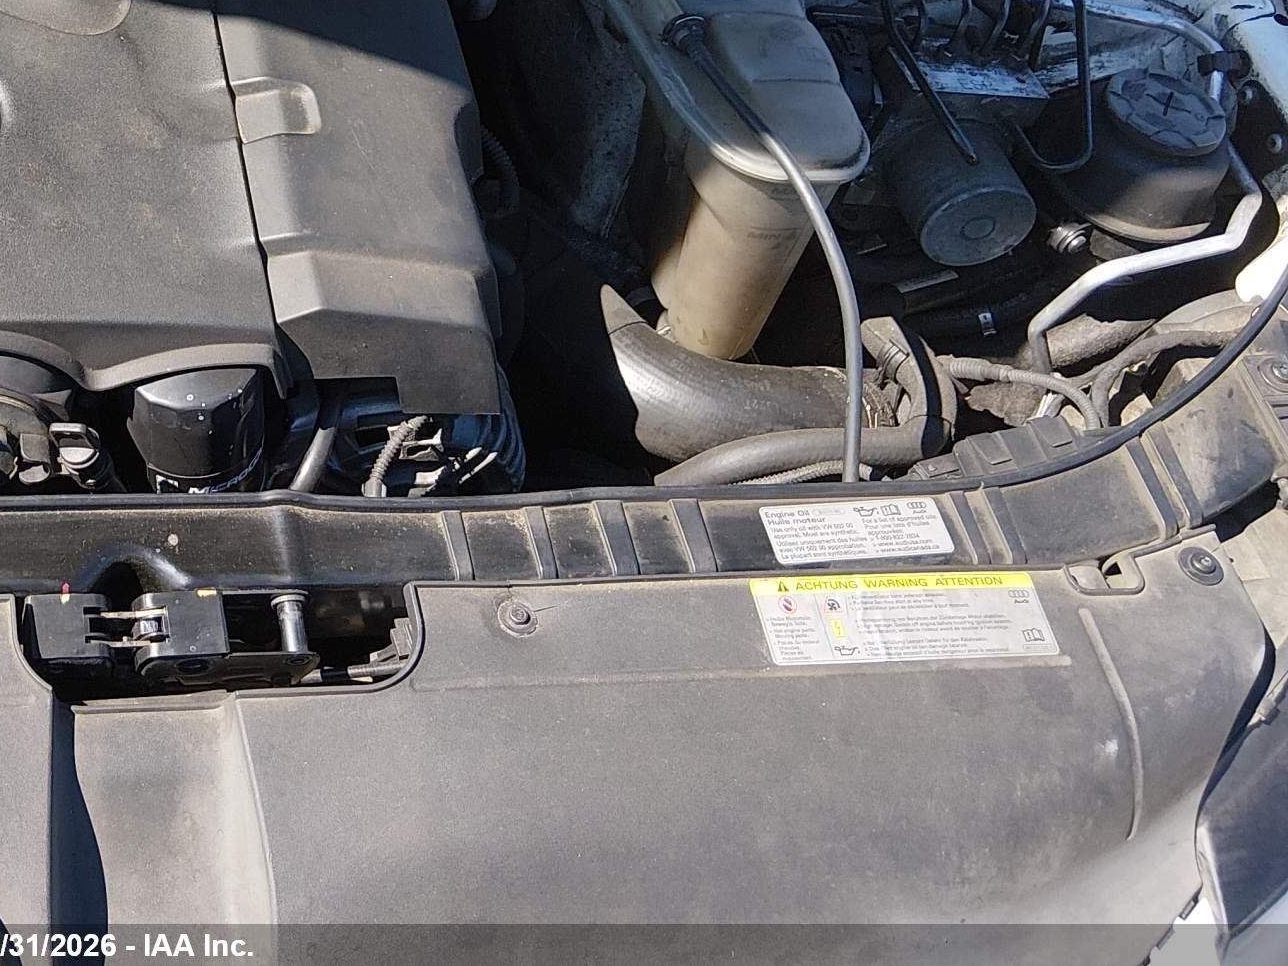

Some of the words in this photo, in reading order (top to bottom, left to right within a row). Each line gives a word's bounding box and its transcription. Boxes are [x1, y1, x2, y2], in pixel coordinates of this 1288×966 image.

[765, 511, 795, 519] Engine
[795, 580, 858, 591] ACHTUNG
[864, 577, 928, 589] WARNING
[935, 576, 1003, 586] ATTENTION
